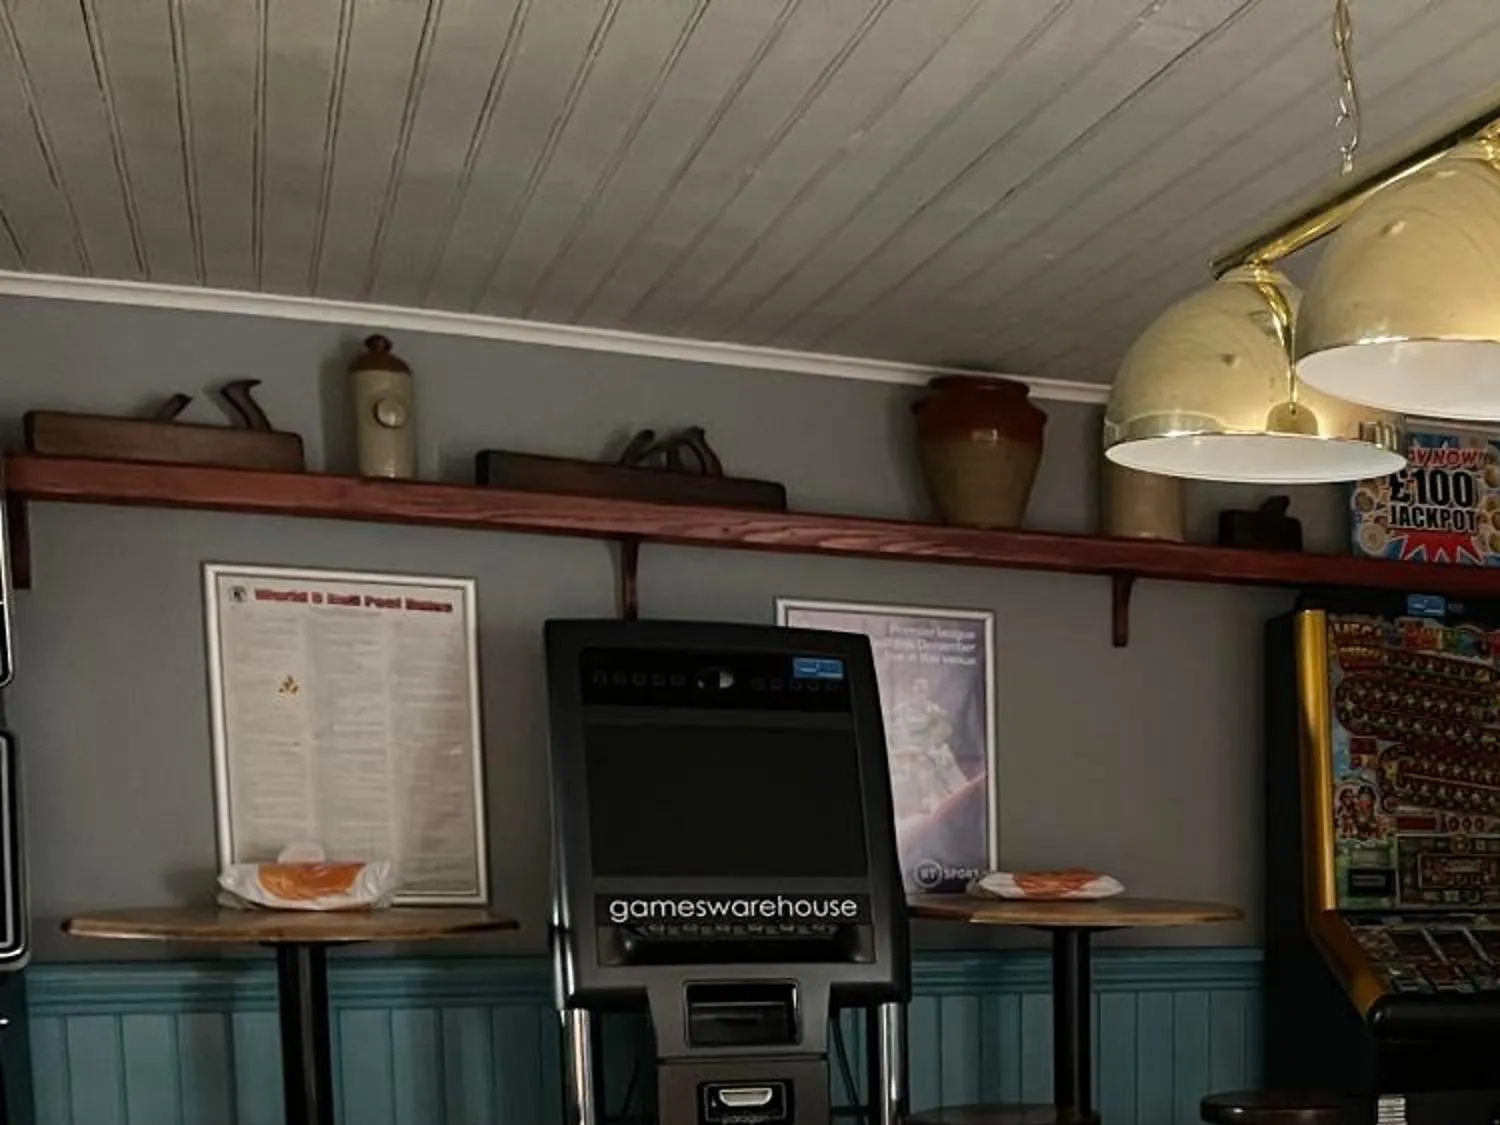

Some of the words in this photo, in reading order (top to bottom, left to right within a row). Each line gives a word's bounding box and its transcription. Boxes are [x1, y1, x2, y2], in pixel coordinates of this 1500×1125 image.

[1389, 467, 1474, 508] £100
[1389, 504, 1475, 532] JACKPOT
[608, 894, 858, 923] gameswarehouse
